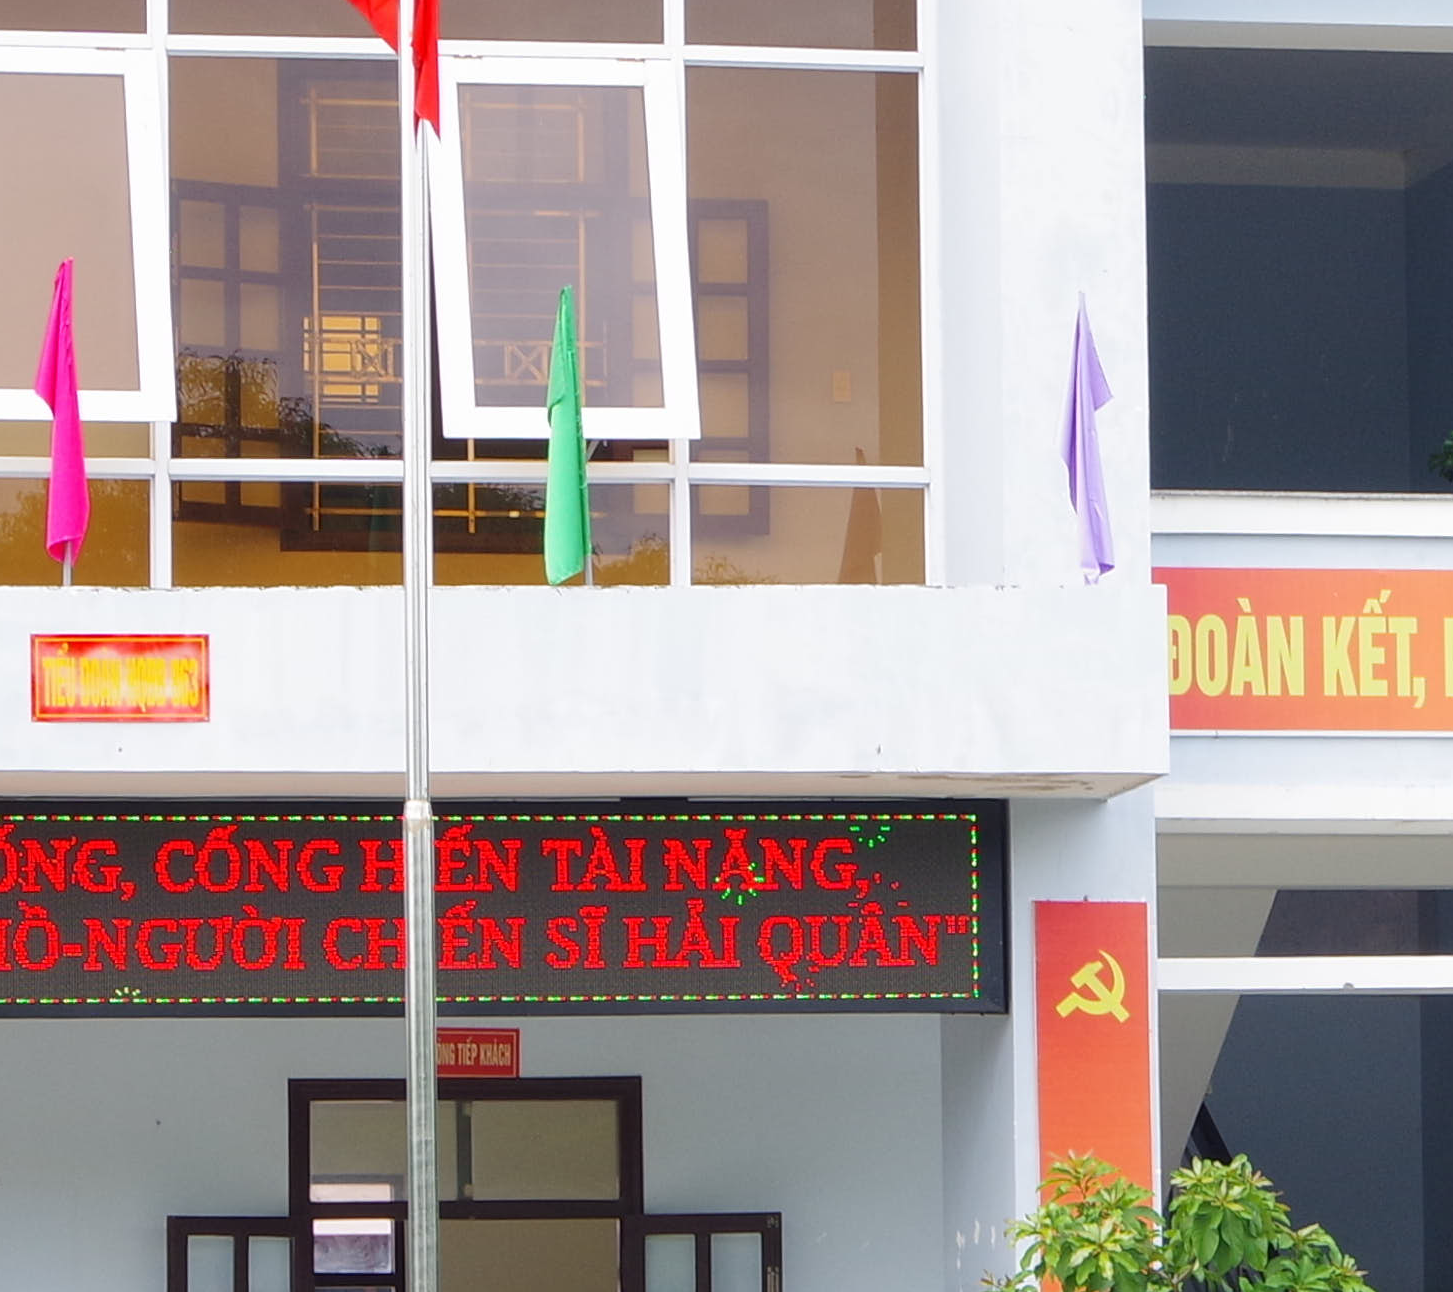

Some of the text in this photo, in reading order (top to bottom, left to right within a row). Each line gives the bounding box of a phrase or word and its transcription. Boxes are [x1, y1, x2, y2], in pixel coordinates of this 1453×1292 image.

[1167, 597, 1305, 697] ĐOÀN
[1323, 589, 1426, 710] KẾT,
[154, 824, 344, 892] CỐNG
[359, 824, 523, 892] HẾN
[541, 826, 647, 892] TÀI
[663, 828, 869, 899] NĂNG,
[322, 900, 526, 970] CHẾN
[545, 905, 609, 969] SĨ
[623, 898, 742, 968] HẢI
